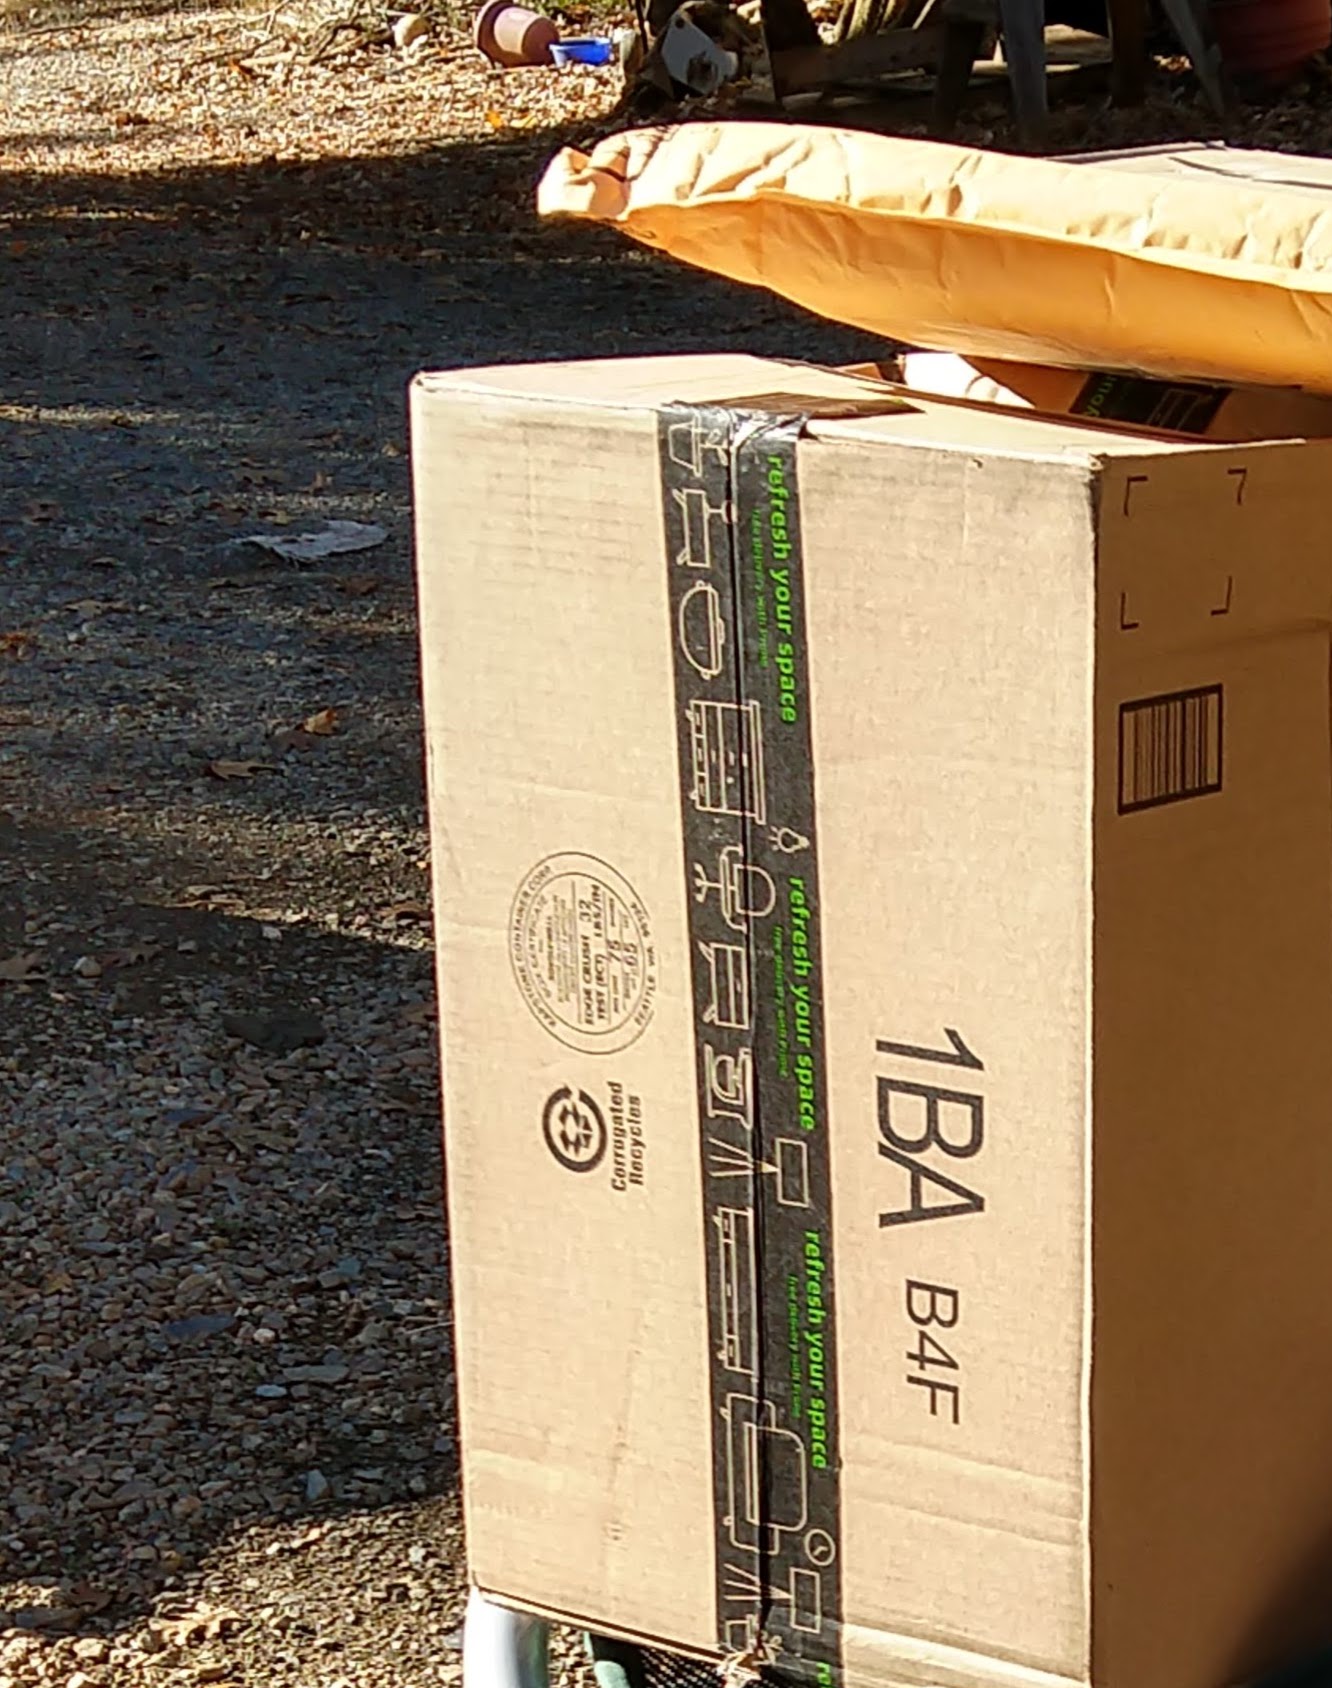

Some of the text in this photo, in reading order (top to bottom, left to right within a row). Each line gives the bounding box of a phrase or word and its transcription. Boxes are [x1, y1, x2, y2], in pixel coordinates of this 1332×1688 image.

[767, 455, 799, 723] refresh your space
[788, 876, 818, 1131] refresh your space
[607, 1081, 627, 1191] Corrugated
[626, 1094, 647, 1187] Recycles
[875, 1025, 987, 1425] 1BA B4F
[804, 1230, 830, 1469] refresh your space
